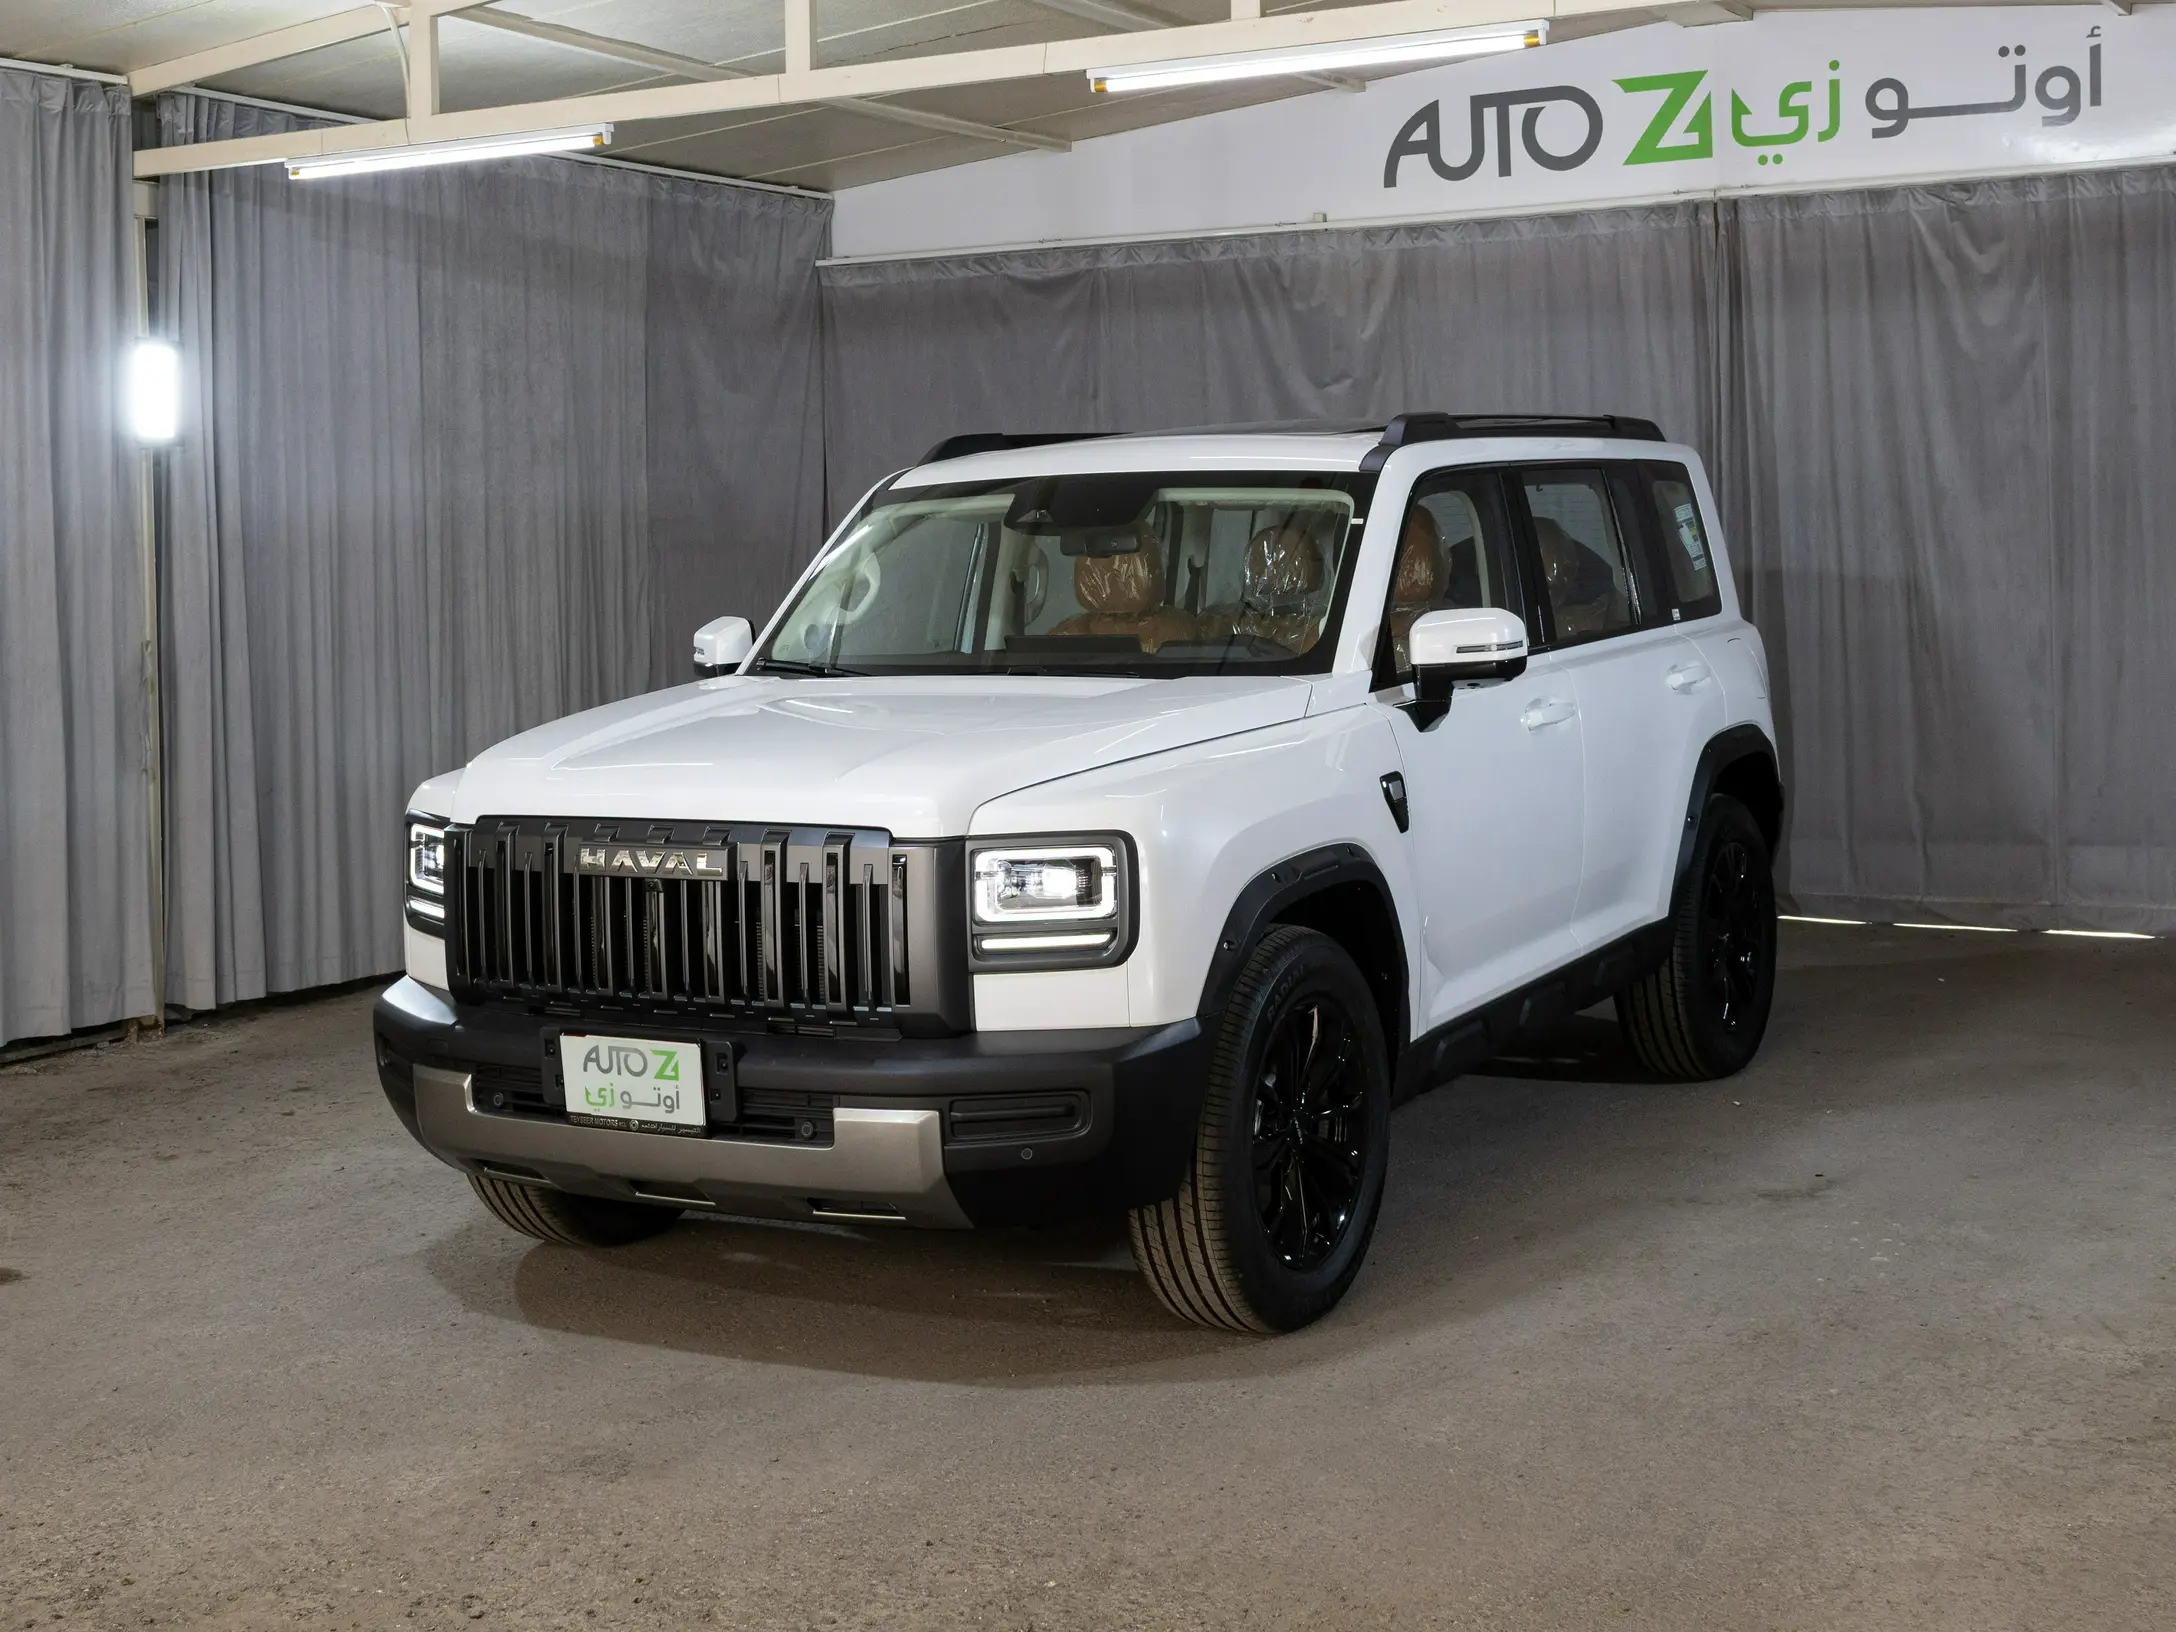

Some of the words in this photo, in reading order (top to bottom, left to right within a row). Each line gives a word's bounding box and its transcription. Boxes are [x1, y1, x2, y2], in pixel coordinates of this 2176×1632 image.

[1383, 84, 1603, 189] AUTO
[1611, 69, 1713, 167] Z
[1730, 59, 1841, 166] زي
[579, 848, 724, 876] HAVAL
[583, 1044, 648, 1077] AUTO
[650, 1049, 680, 1081] Z
[584, 1082, 616, 1112] زي
[570, 1115, 594, 1125] TEYSEER
[594, 1117, 618, 1128] MOTORS
